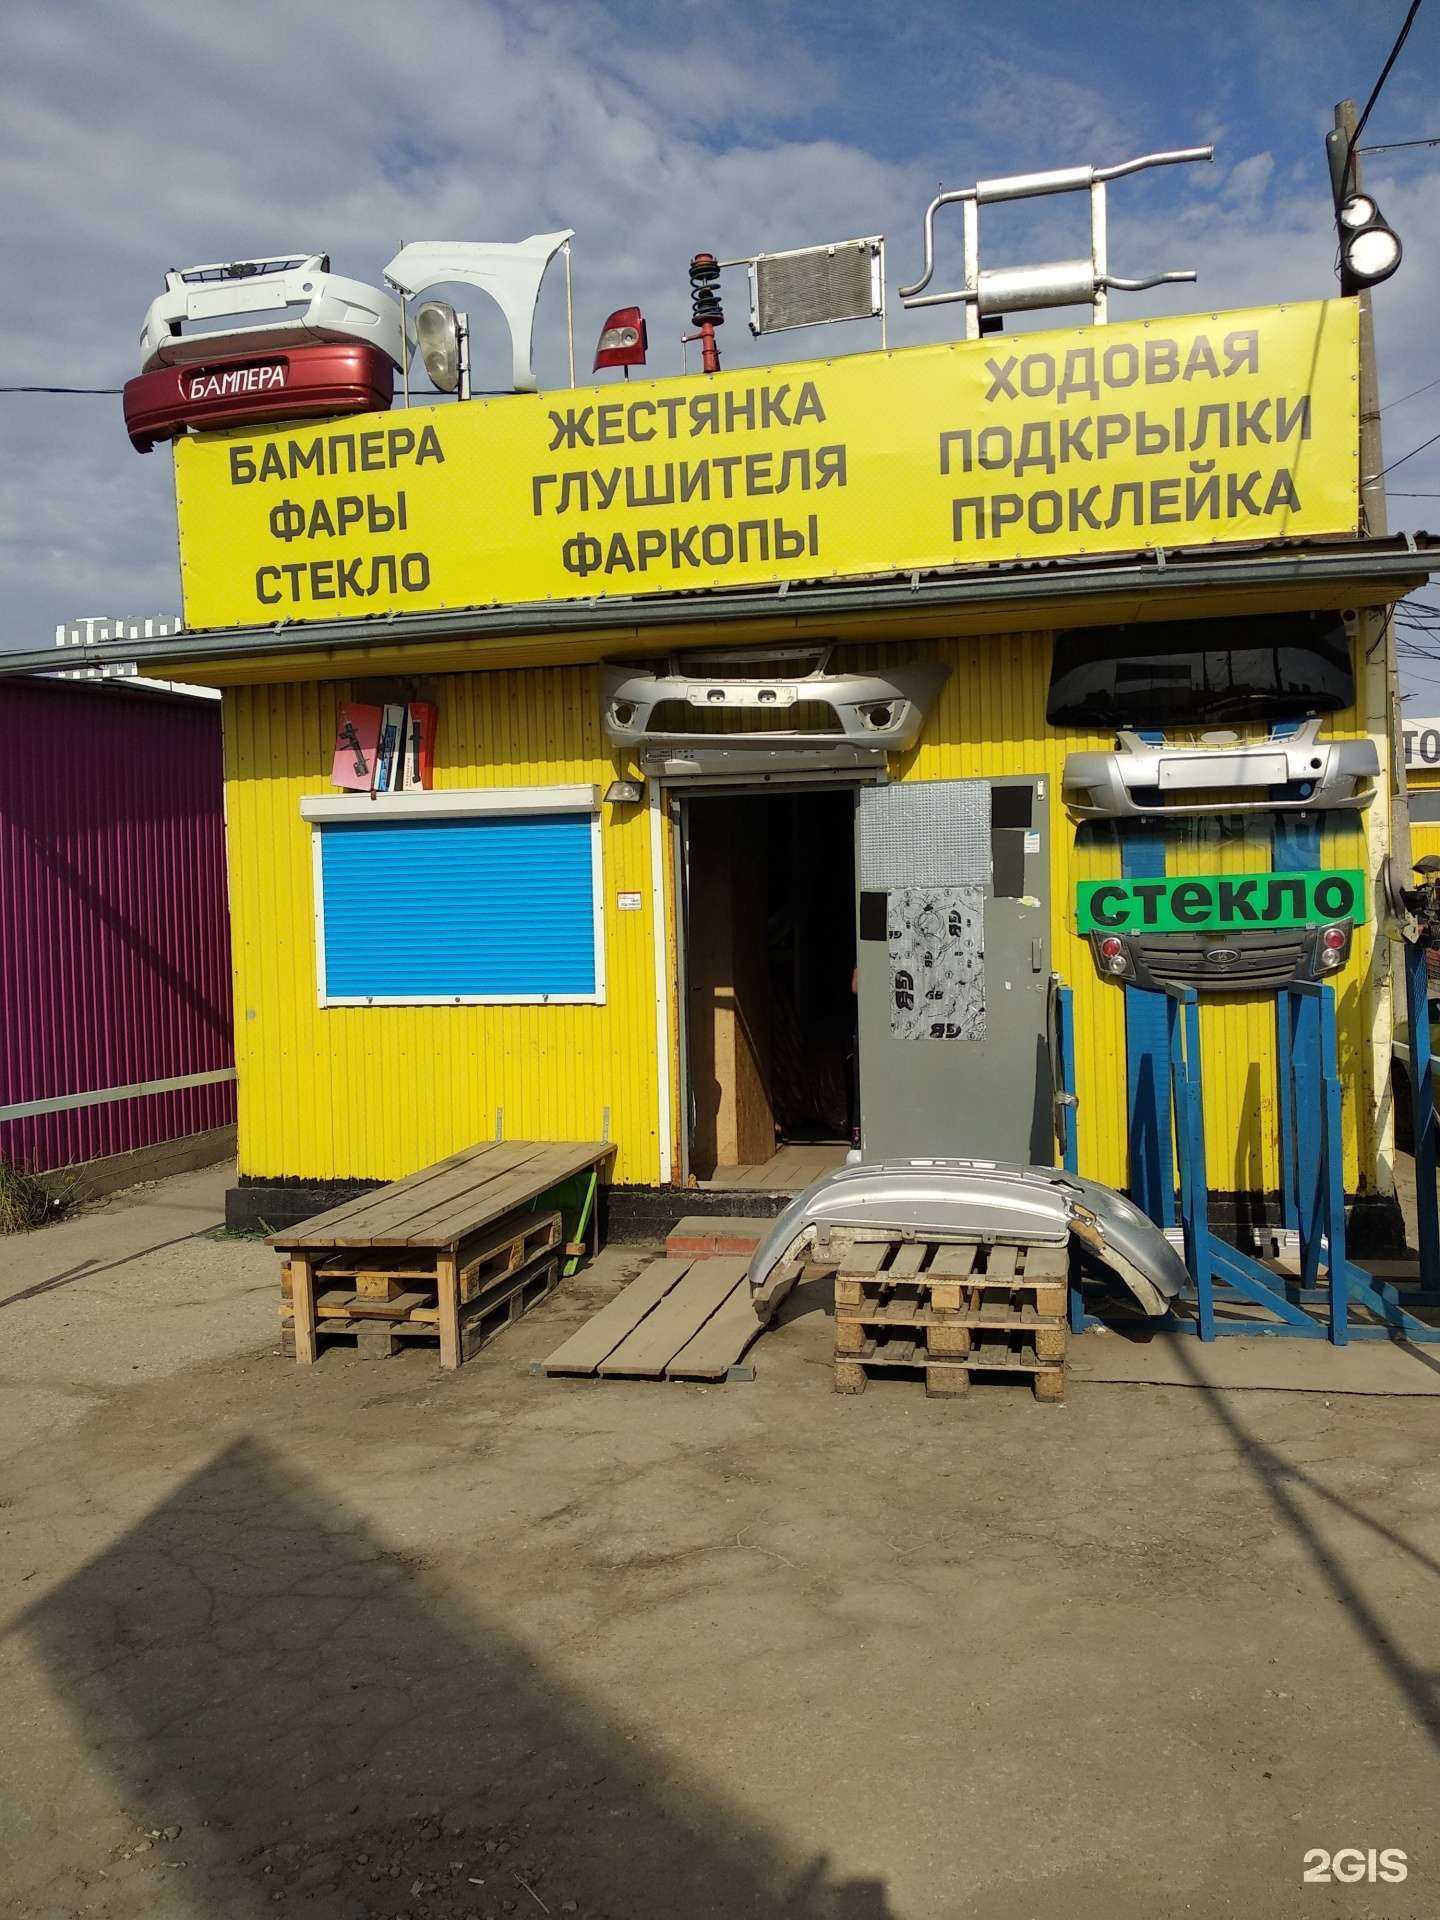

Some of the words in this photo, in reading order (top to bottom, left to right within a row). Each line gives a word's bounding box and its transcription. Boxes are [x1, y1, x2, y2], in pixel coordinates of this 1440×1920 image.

[190, 365, 285, 399] БАМПЕРА
[984, 330, 1259, 404] ХОДОВАЯ
[547, 381, 827, 452] ЖЕСТЯНКА
[939, 395, 1311, 478] ПОДКРЫЛКИ
[229, 425, 446, 485] БАМПЕРА
[532, 443, 848, 517] ГЛУШИТЕЛЯ
[269, 490, 408, 543] ФАРЫ
[951, 459, 1302, 542] ПРОКЛЕЙКА
[561, 514, 819, 578] ФАРКОПЫ
[256, 552, 431, 605] СТЕКЛО
[1090, 877, 1354, 926] стекло
